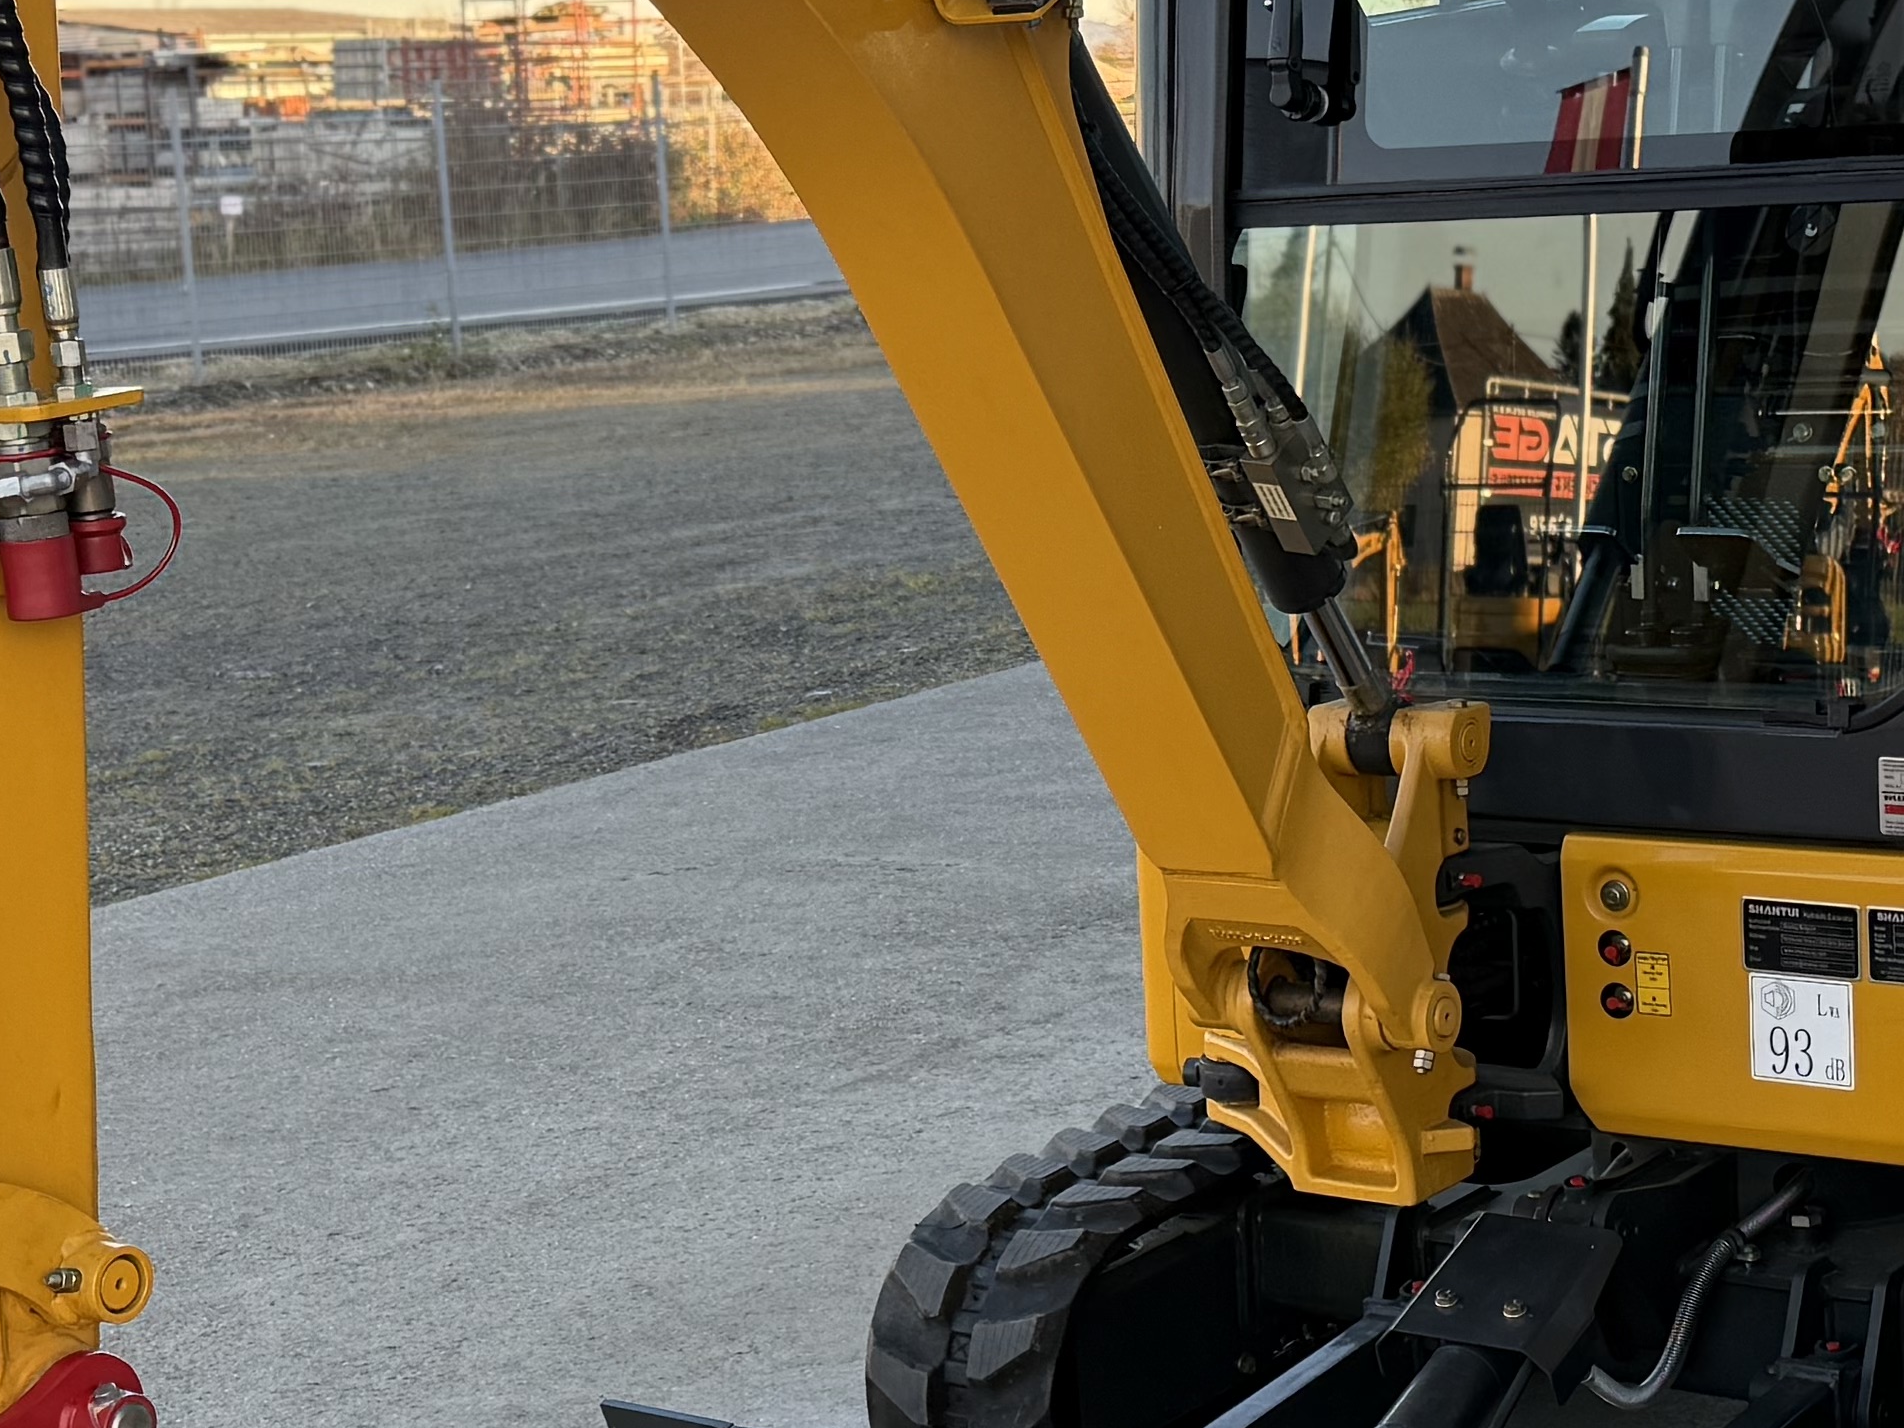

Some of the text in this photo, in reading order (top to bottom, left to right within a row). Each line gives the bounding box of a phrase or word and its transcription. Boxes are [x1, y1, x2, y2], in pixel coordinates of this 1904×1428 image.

[1748, 904, 1799, 918] SHANTUI
[1769, 1026, 1846, 1082] 93 dB
